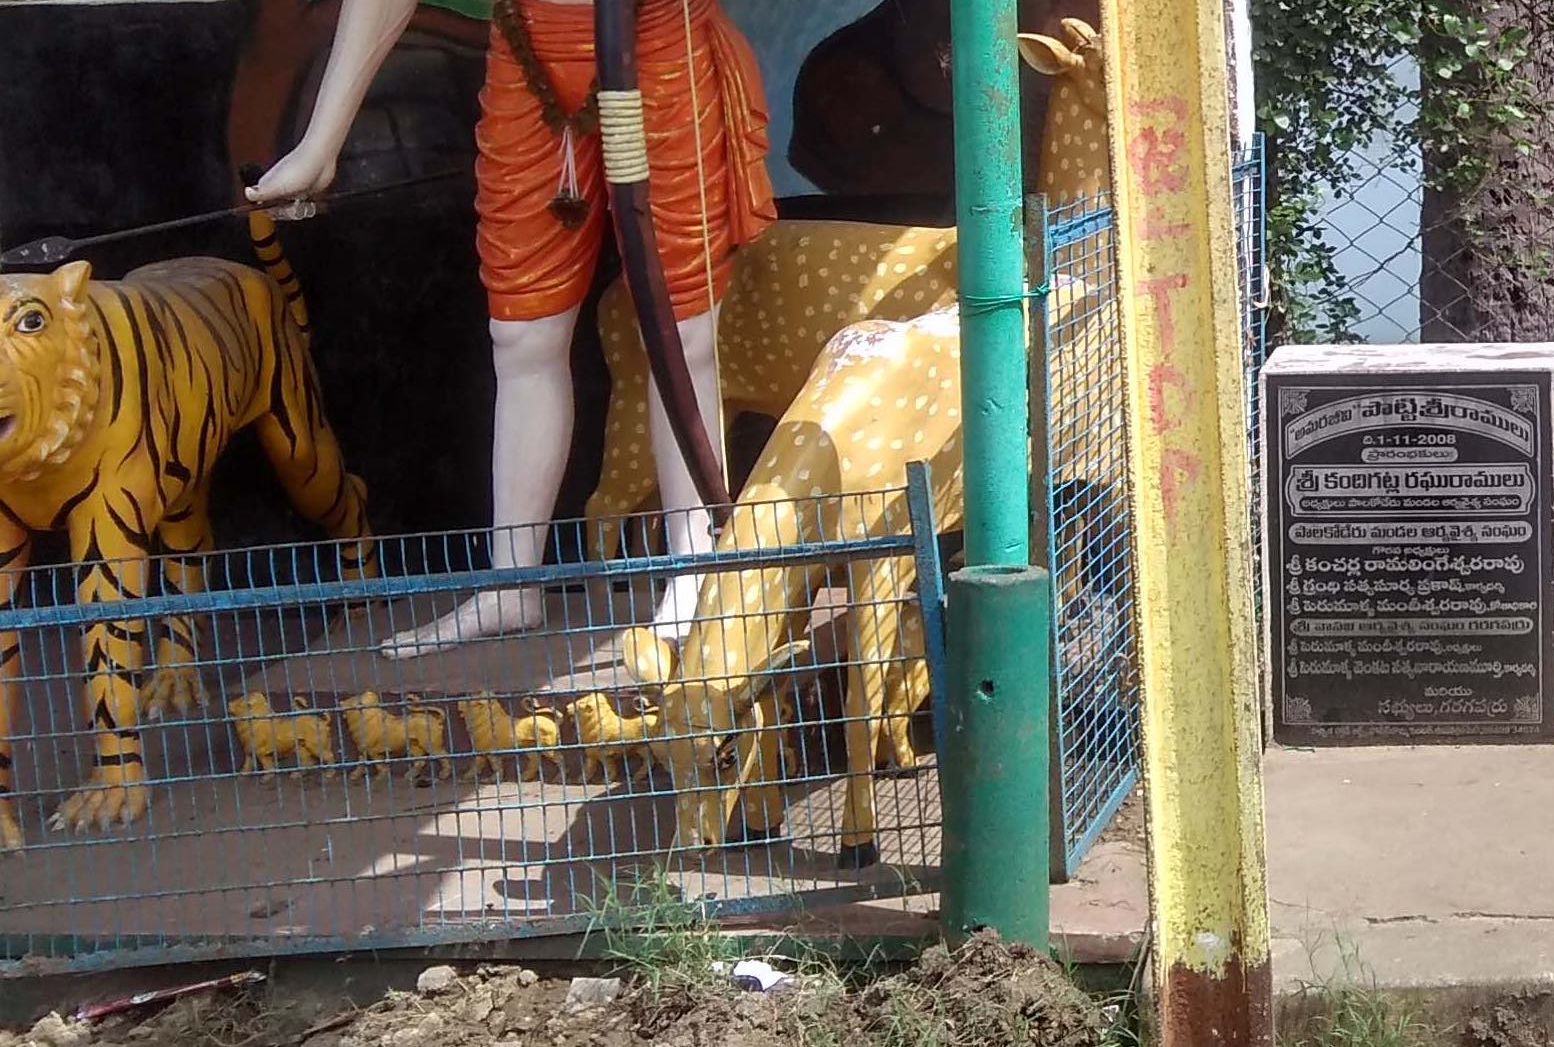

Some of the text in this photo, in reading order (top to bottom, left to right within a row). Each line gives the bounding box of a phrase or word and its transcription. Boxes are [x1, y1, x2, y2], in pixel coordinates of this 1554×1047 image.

[1296, 469, 1319, 492] శ్రీ
[1404, 470, 1525, 491] రఘురాములు
[1370, 524, 1417, 538] మండల
[1481, 523, 1526, 538] సంఘం
[1286, 554, 1525, 576] శ్రీ కంచర్ల రామలింగేశ్వరరావు
[1286, 576, 1301, 595] శ్రీ
[1286, 596, 1301, 615] శ్రీ
